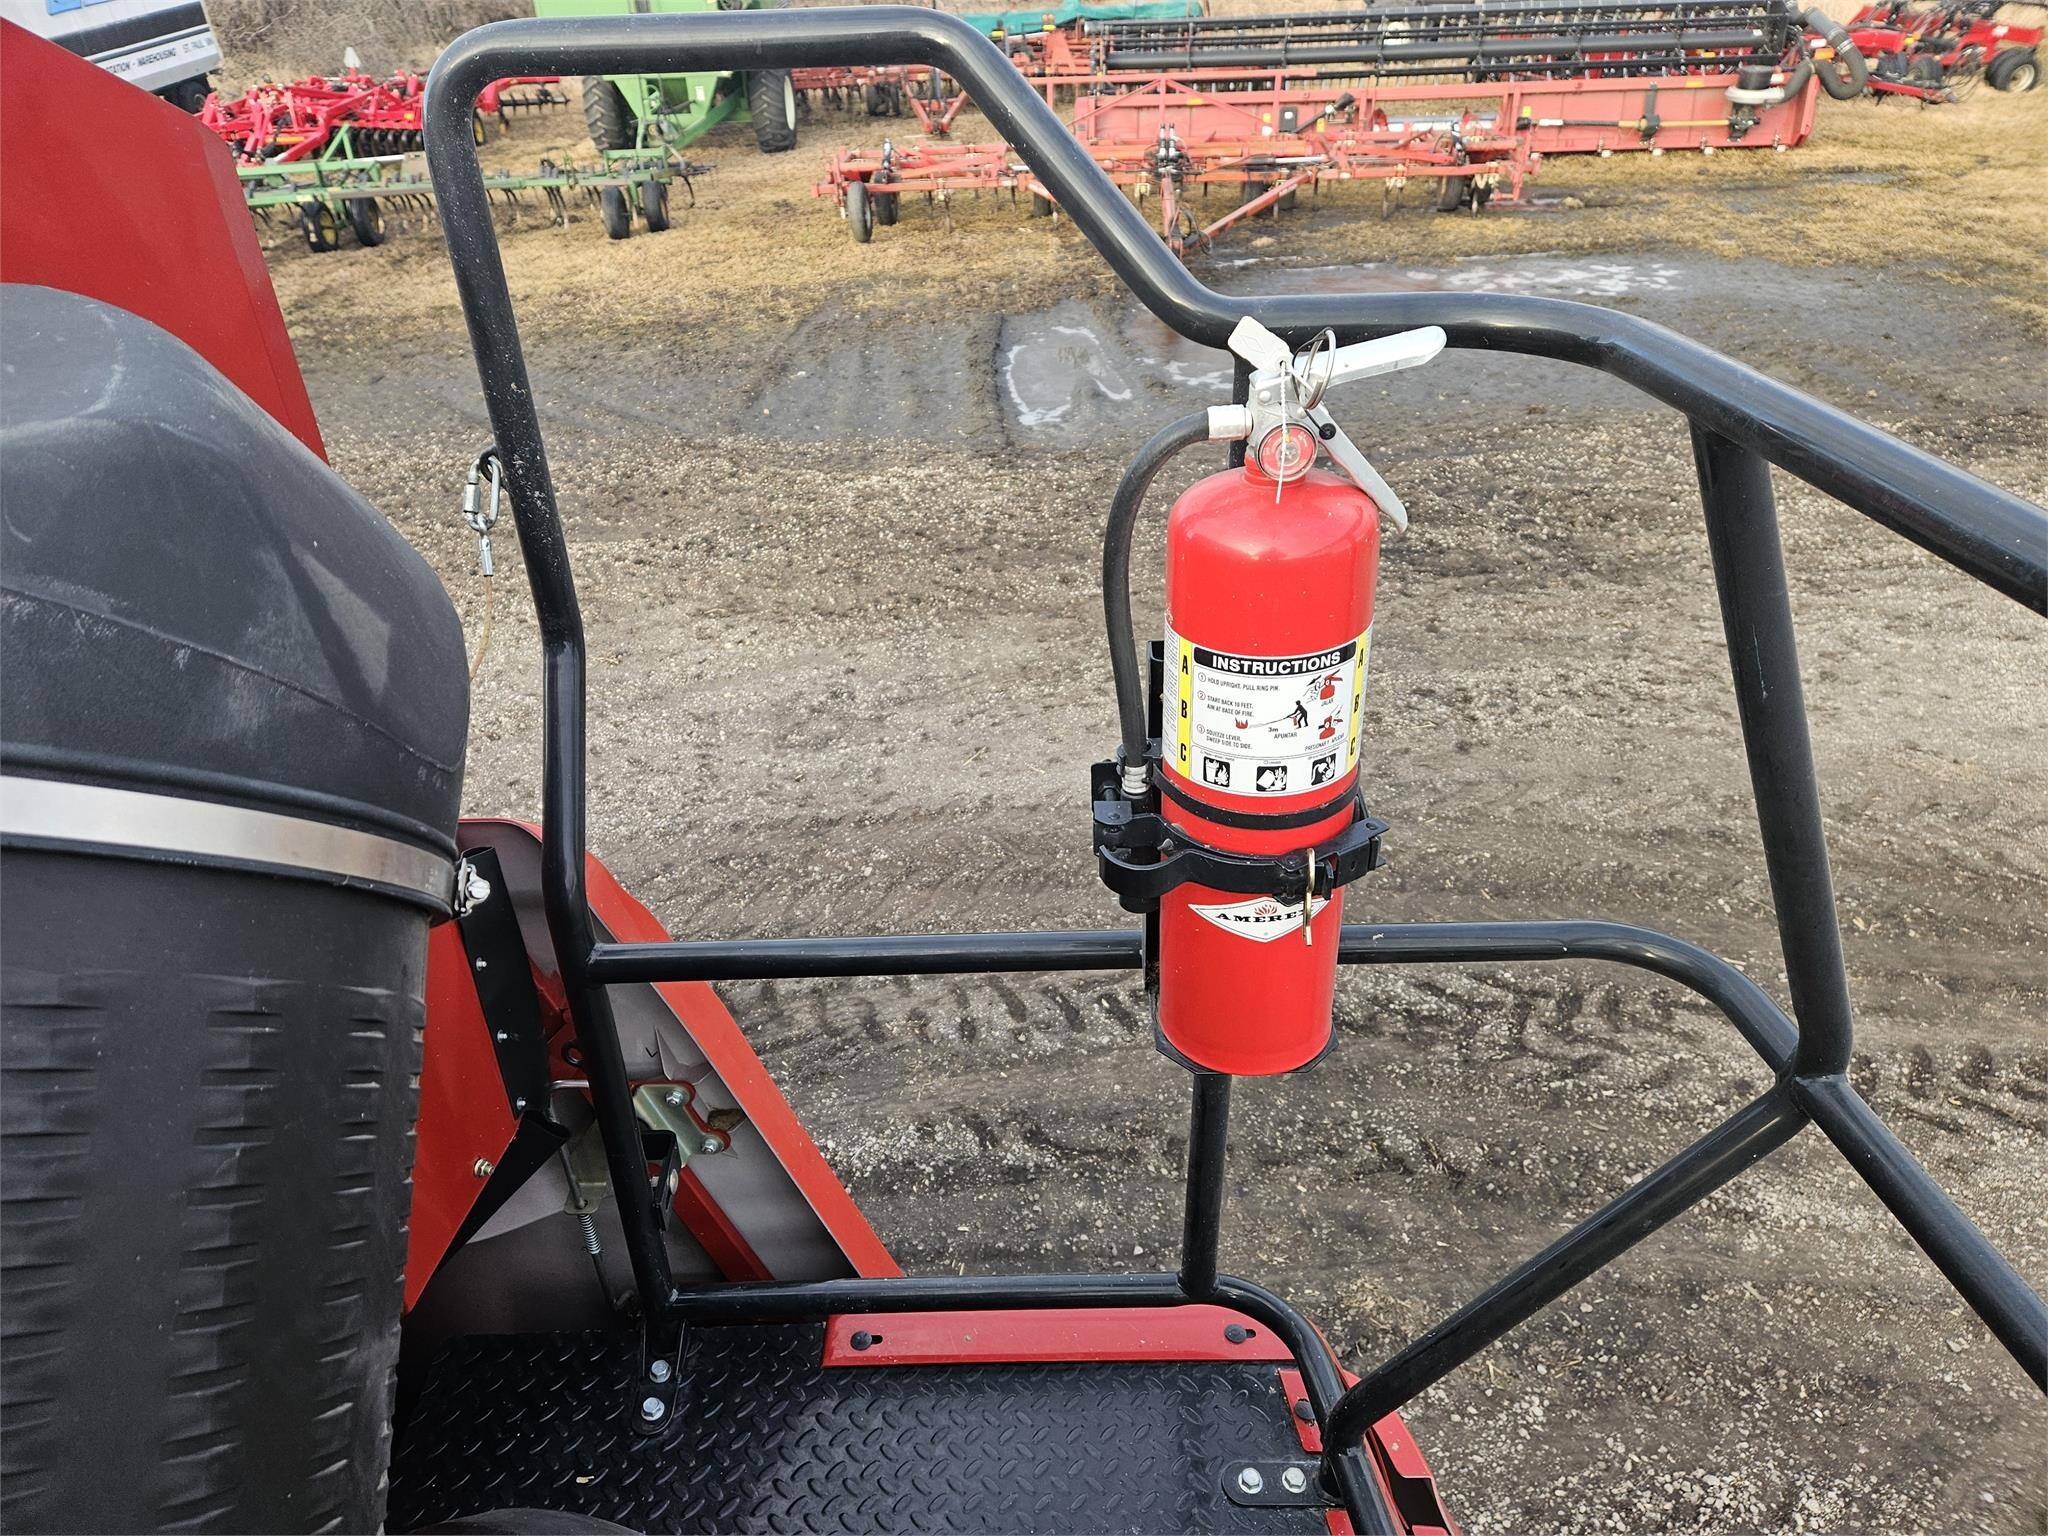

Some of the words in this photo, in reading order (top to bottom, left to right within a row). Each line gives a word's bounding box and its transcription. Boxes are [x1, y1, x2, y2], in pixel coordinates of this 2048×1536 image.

[1181, 655, 1189, 675] A
[1212, 651, 1341, 675] INSTRUCTIONS
[1358, 648, 1363, 669] A
[1207, 677, 1219, 685] HOLD
[1181, 700, 1187, 719] B
[1221, 698, 1233, 706] BACK
[1222, 706, 1233, 715] BASE
[1354, 693, 1360, 713] B
[1180, 743, 1187, 762] C
[1350, 737, 1355, 756] C
